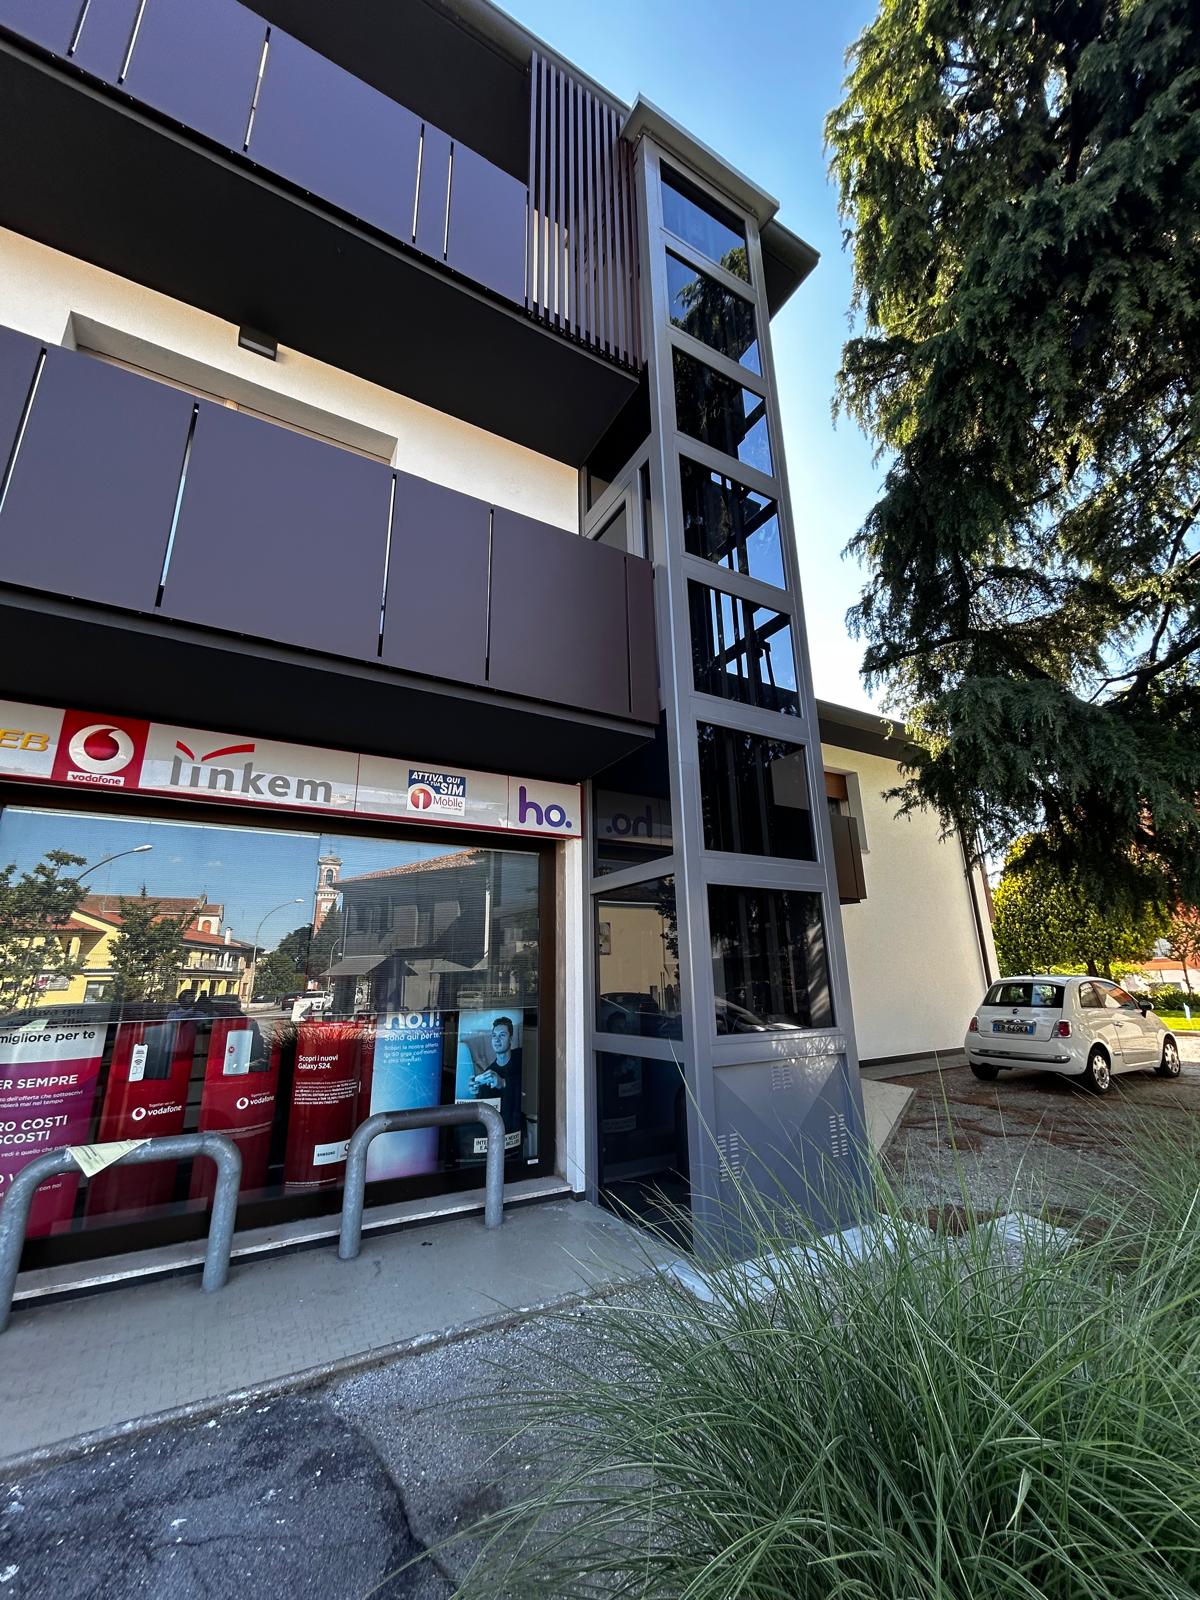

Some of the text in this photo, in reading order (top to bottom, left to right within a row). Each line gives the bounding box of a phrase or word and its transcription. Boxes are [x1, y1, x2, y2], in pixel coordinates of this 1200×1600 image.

[71, 773, 122, 785] vodafone
[169, 754, 333, 803] linkem
[411, 771, 460, 784] ATTIVA QUI
[439, 782, 464, 796] SIM
[433, 795, 463, 808] Mobile
[518, 785, 573, 828] ho.
[0, 1030, 96, 1045] migliore per te
[420, 1031, 432, 1040] per
[298, 1054, 317, 1063] Scopri
[320, 1053, 339, 1062] nuovi
[298, 1062, 317, 1071] Galaxy
[17, 1074, 79, 1089] SEMPRE
[250, 1095, 275, 1105] vodafone
[147, 1105, 182, 1116] vodafone
[21, 1114, 68, 1131] COSTI
